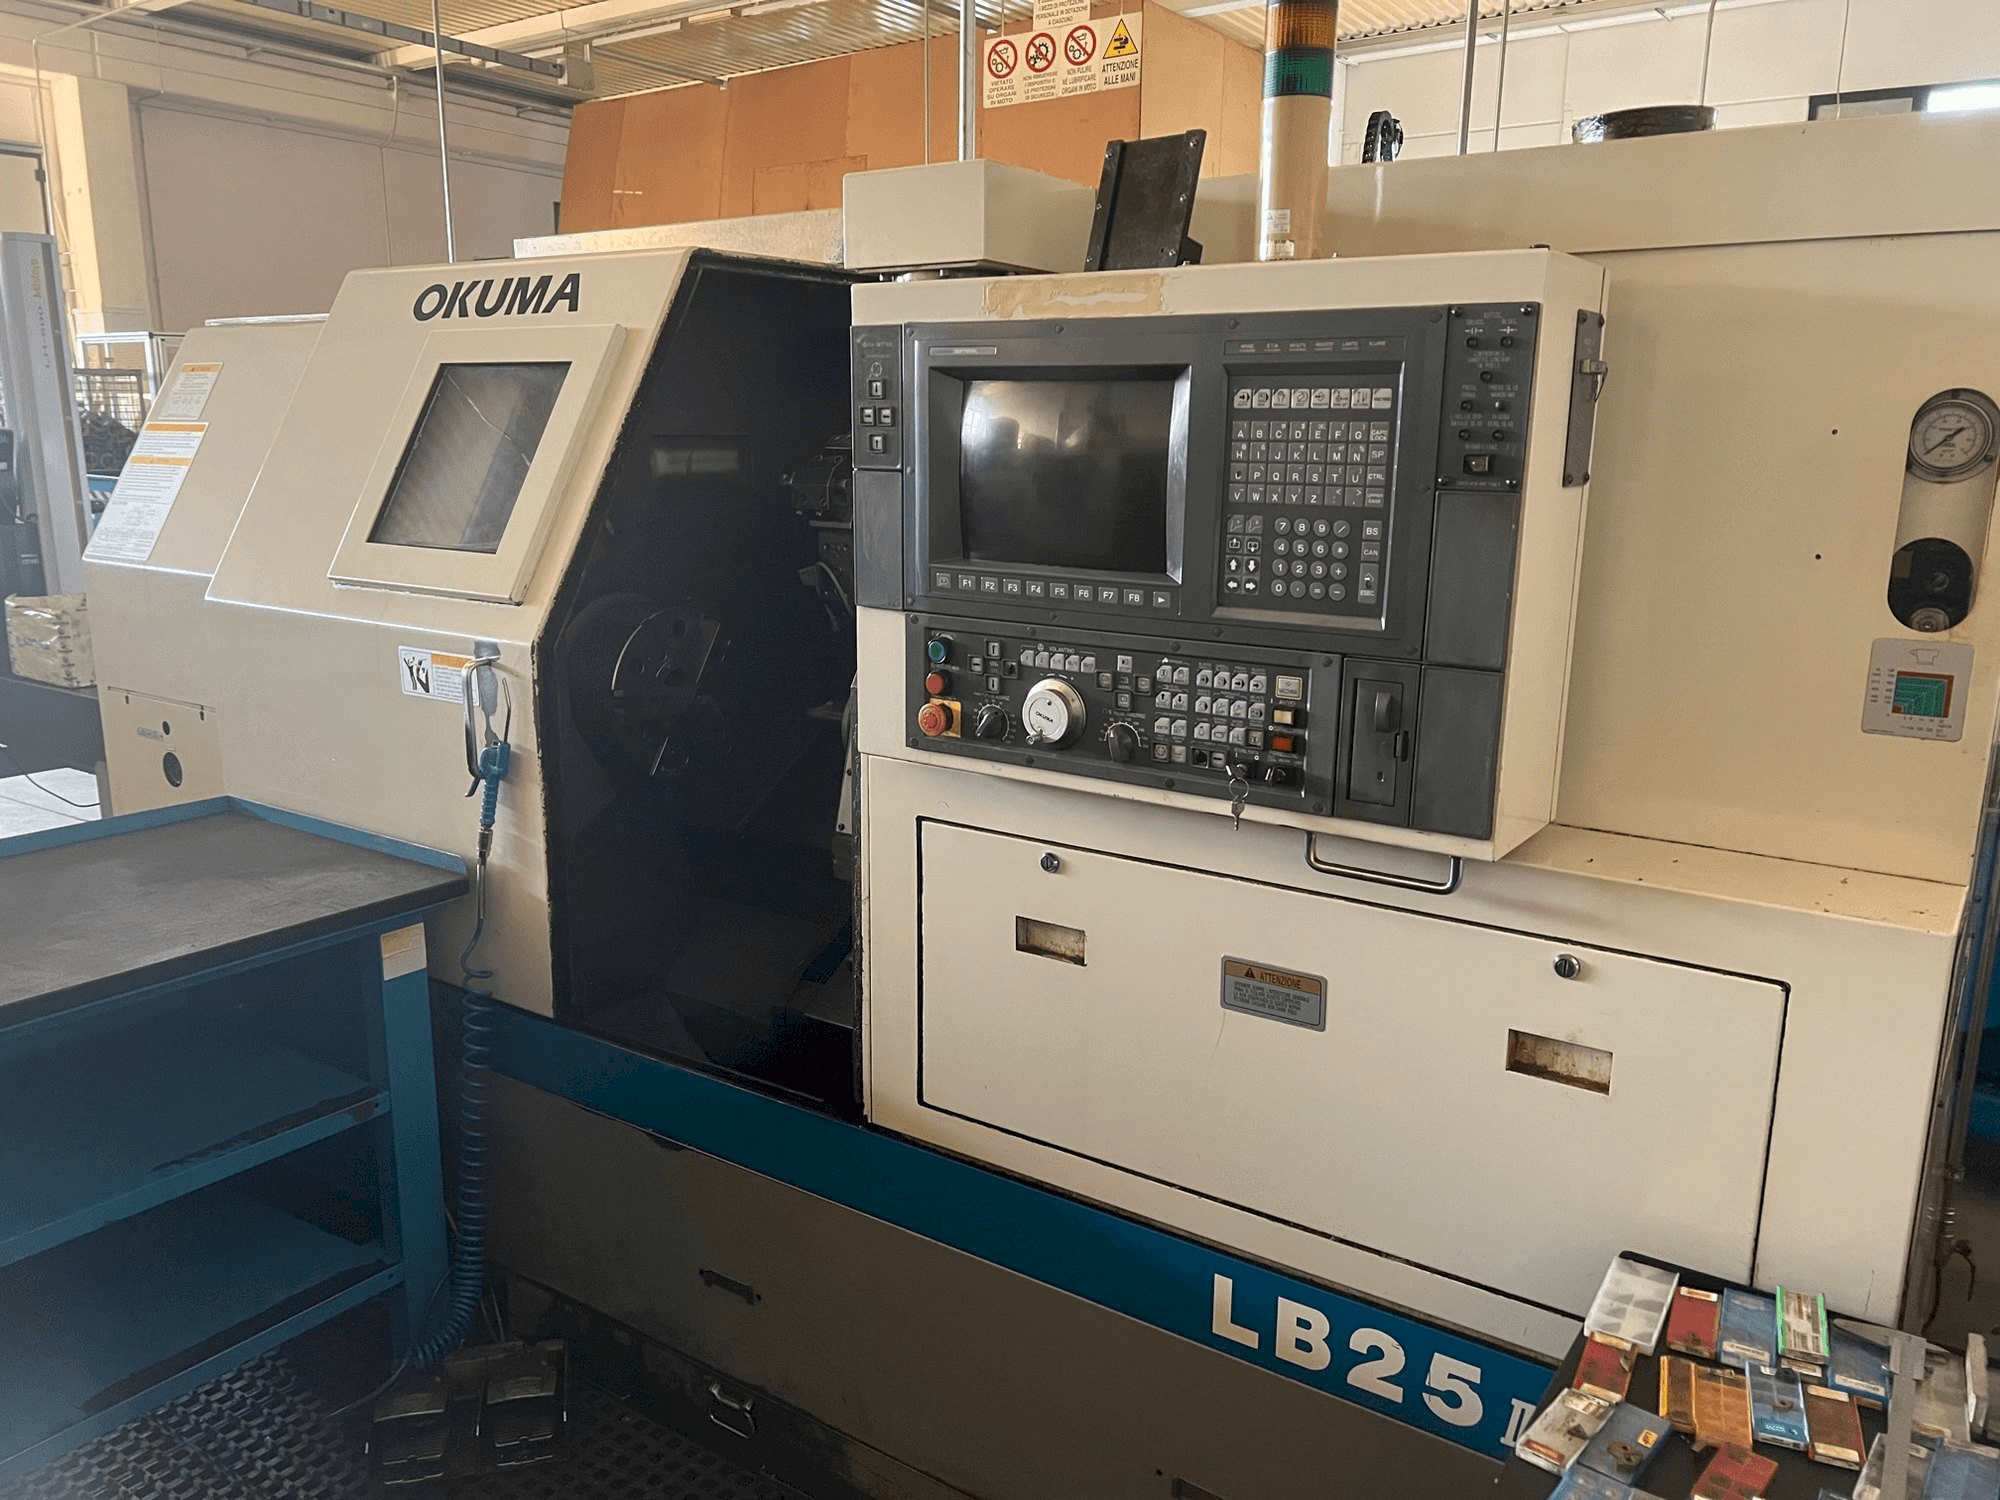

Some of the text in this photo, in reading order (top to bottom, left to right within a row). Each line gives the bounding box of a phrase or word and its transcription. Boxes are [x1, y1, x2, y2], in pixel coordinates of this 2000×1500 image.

[1102, 59, 1138, 74] ATTENZIONE
[1104, 72, 1136, 85] ALLE MANI
[989, 85, 1014, 93] OPERARE
[1084, 83, 1096, 91] MOTO
[413, 273, 580, 321] OKUMA
[1315, 431, 1321, 439] E
[1335, 431, 1341, 439] F
[1294, 452, 1300, 460] K
[1313, 452, 1319, 460] L
[1272, 473, 1279, 481] Q
[1332, 474, 1338, 482] T
[1352, 475, 1358, 483] U
[1234, 492, 1240, 500] V
[1291, 494, 1298, 502] Y
[1310, 495, 1317, 503] Z
[1280, 522, 1286, 530] 7
[1299, 523, 1305, 531] 8
[1319, 524, 1325, 532] 9
[1366, 527, 1378, 535] BS
[1278, 543, 1284, 551] 4
[1297, 544, 1304, 552] 5
[1317, 545, 1324, 554] 6
[1278, 564, 1282, 572] 1
[1296, 565, 1302, 573] 2
[1316, 566, 1322, 574] 3
[963, 580, 972, 588] F1
[985, 581, 995, 590] F2
[1008, 583, 1018, 592] F3
[1276, 584, 1282, 592] 0
[1031, 585, 1041, 594] F4
[1054, 588, 1065, 596] F5
[1078, 589, 1088, 598] F6
[1103, 592, 1114, 600] F7
[1129, 594, 1139, 602] F8
[1049, 646, 1074, 654] VOLANTINO
[1260, 972, 1302, 989] ATTENZIONE
[1212, 1273, 1483, 1426] LB25
